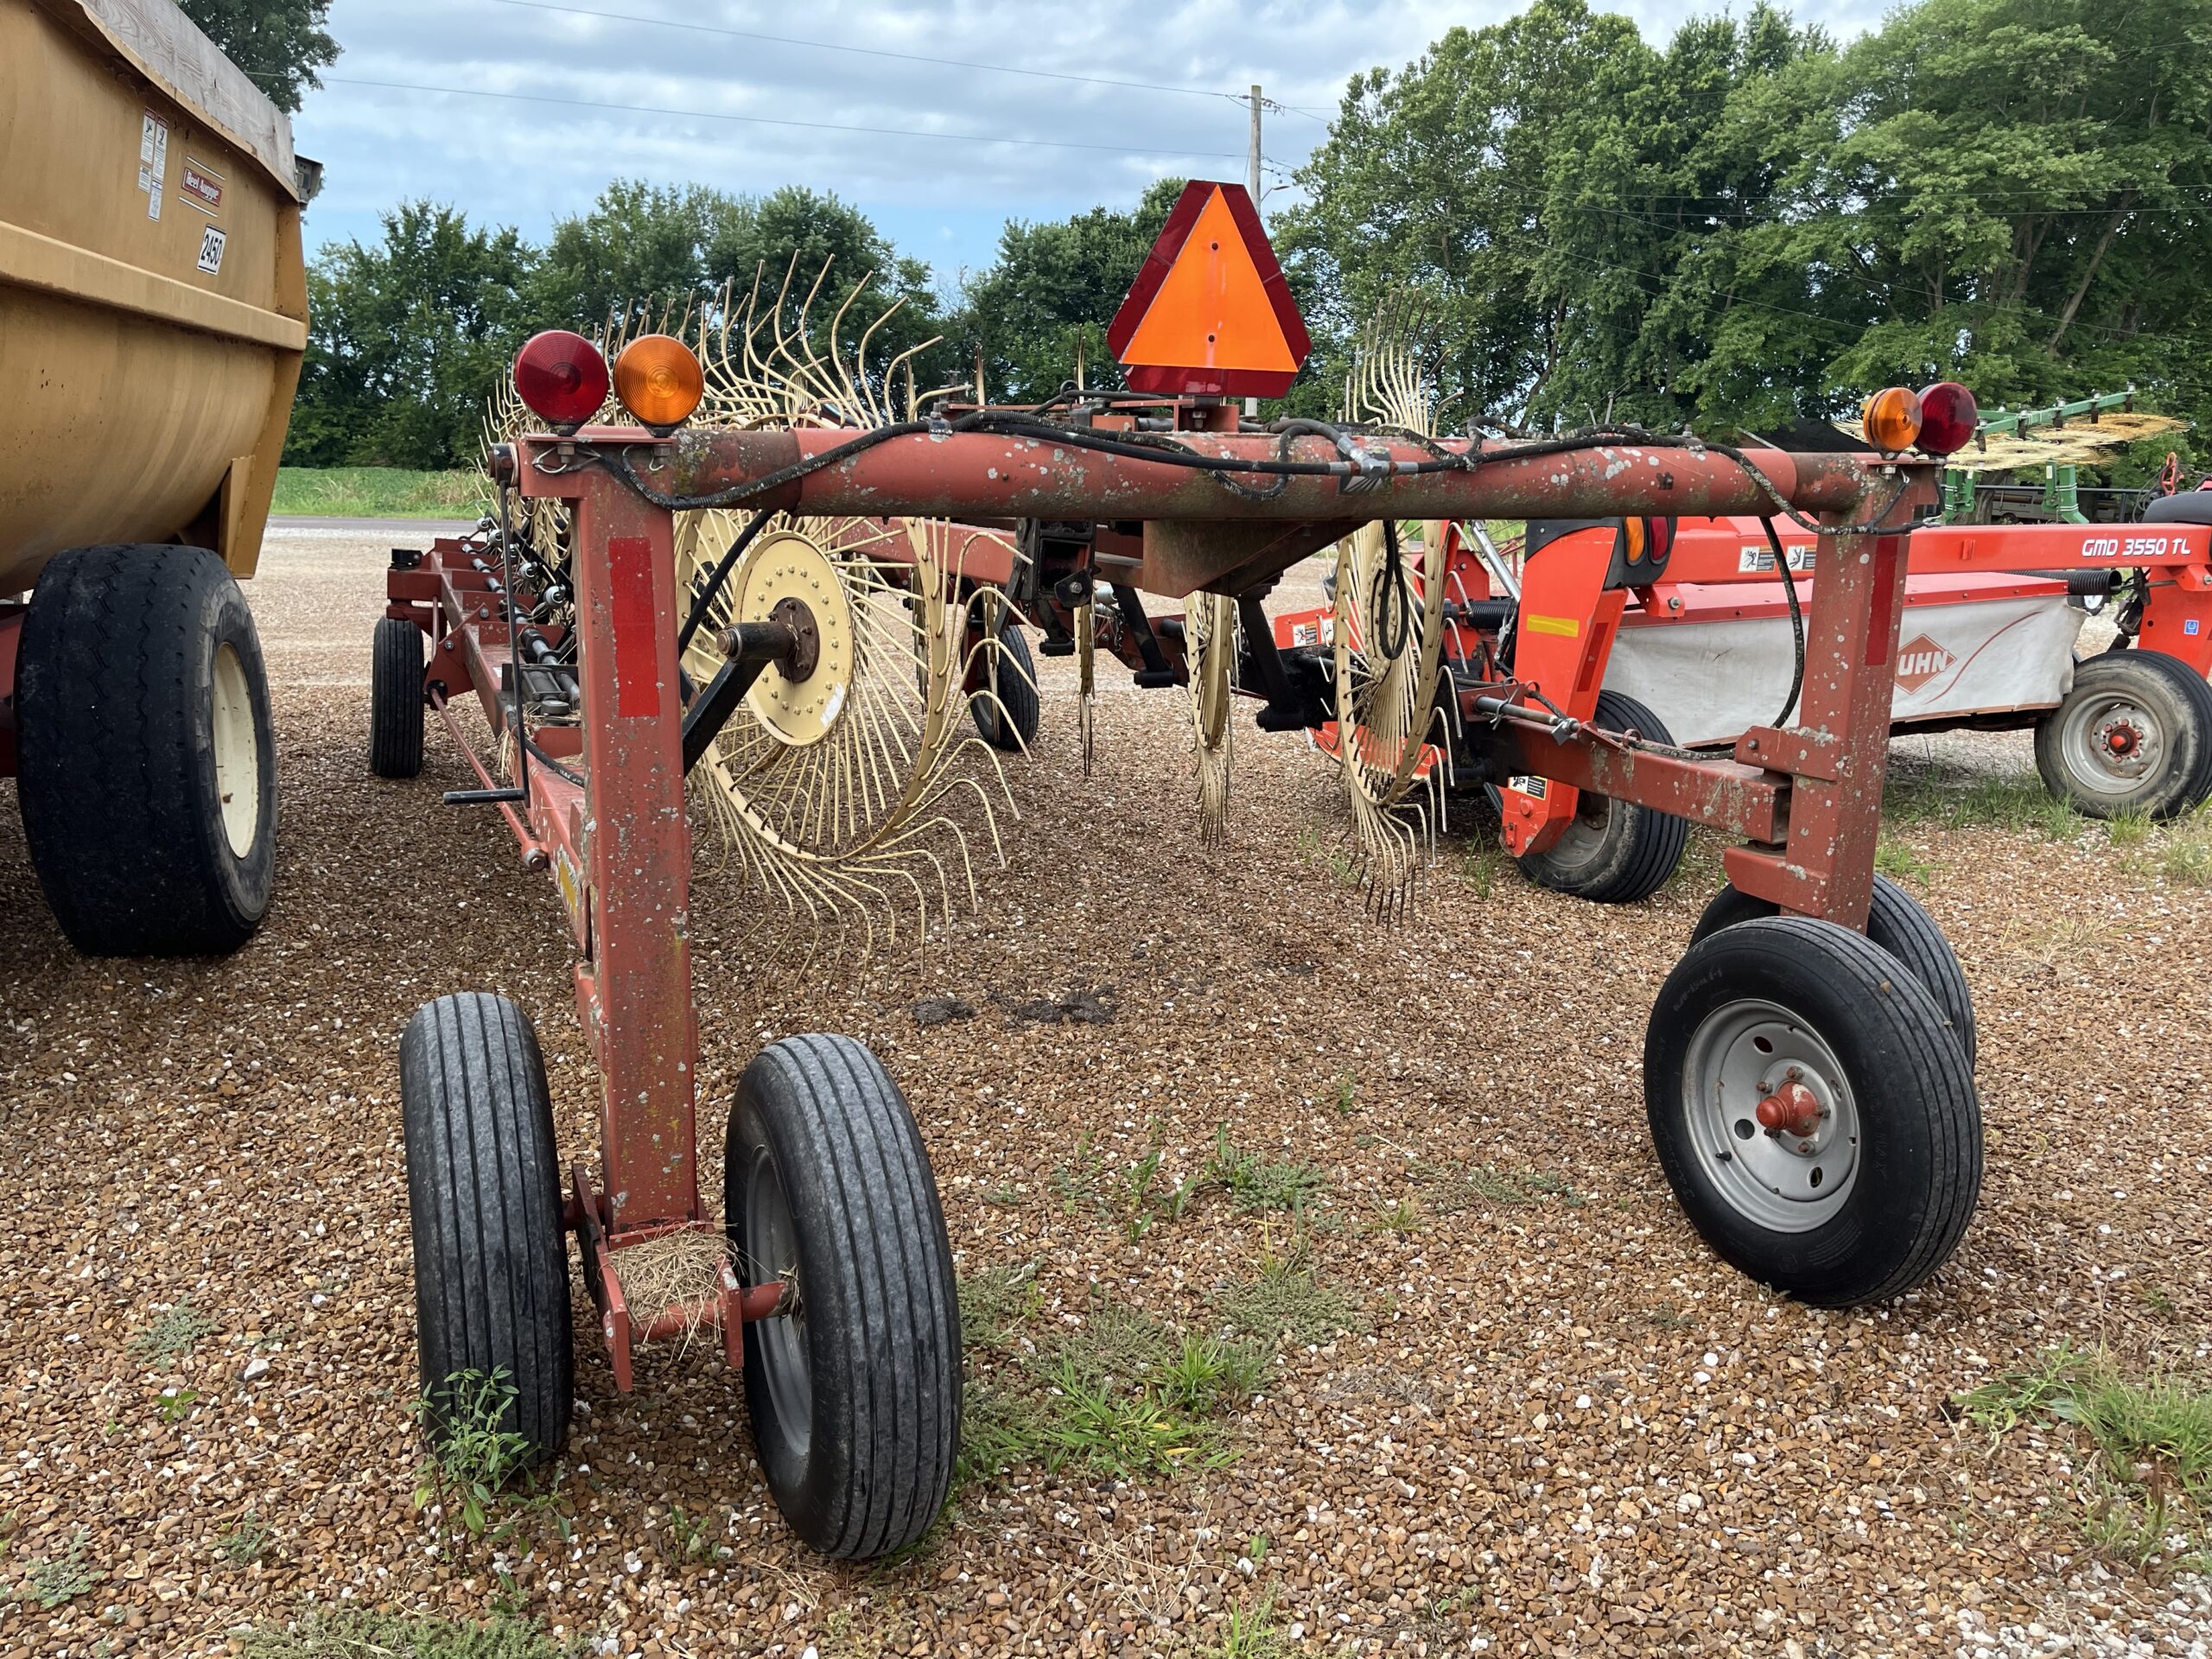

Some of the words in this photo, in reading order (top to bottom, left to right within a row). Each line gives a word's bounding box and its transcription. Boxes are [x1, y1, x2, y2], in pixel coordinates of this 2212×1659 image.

[186, 171, 200, 189] Reel
[200, 233, 222, 265] 2450
[2082, 538, 2119, 556] GMD
[2122, 537, 2167, 556] 3550
[2171, 537, 2191, 555] TL
[1897, 650, 1948, 677] UHN
